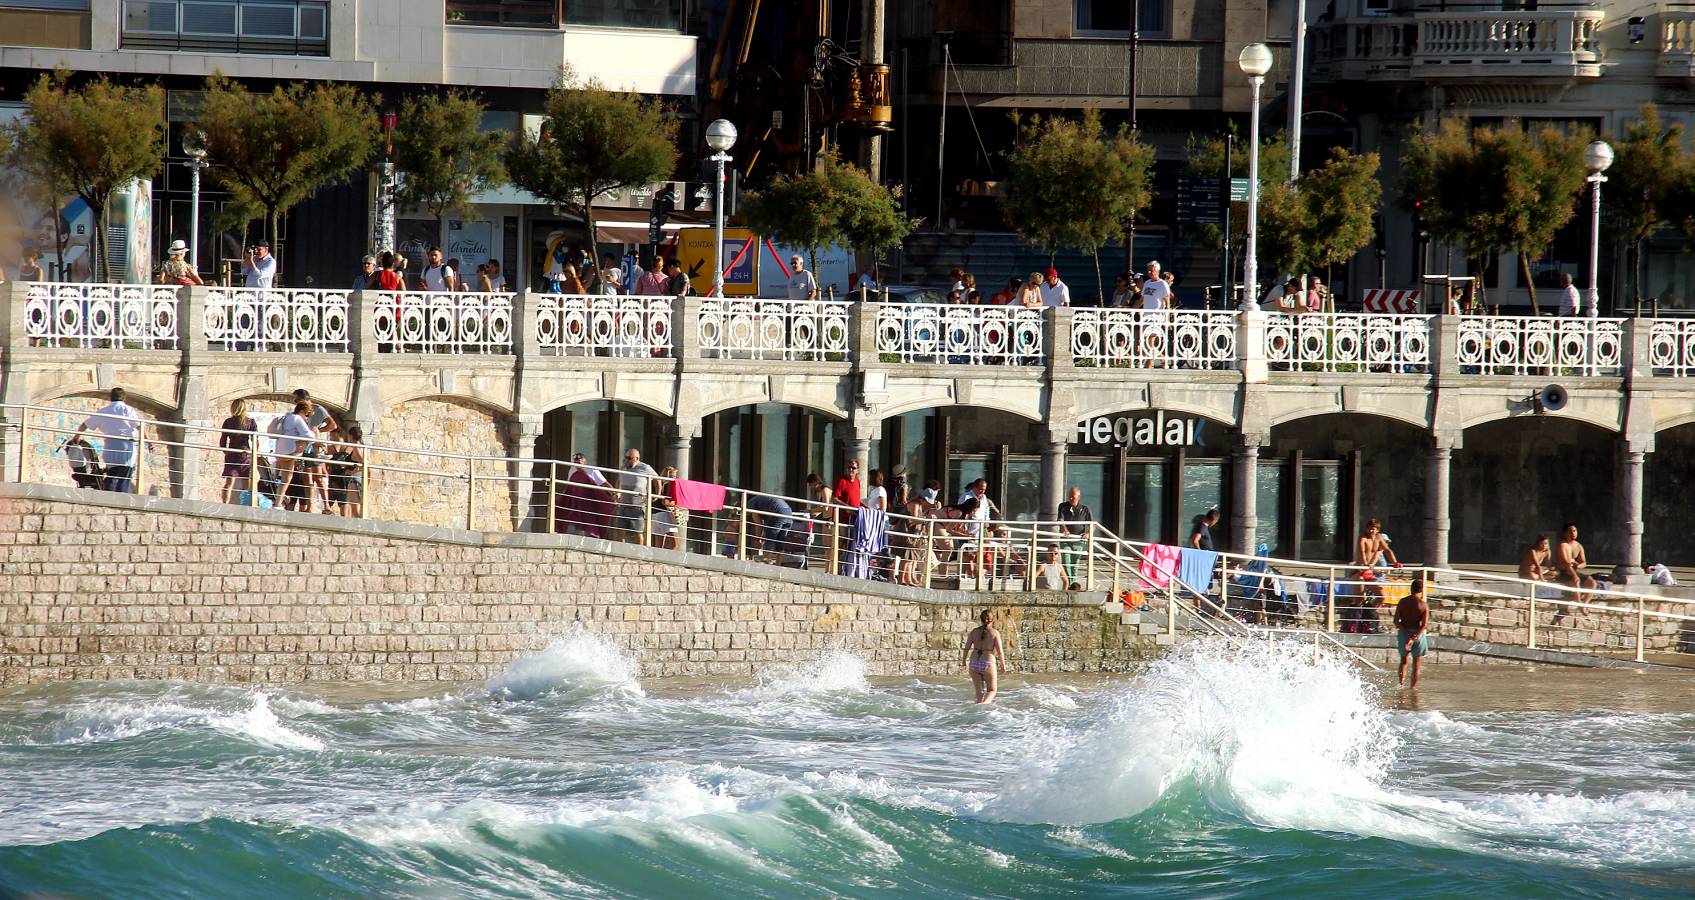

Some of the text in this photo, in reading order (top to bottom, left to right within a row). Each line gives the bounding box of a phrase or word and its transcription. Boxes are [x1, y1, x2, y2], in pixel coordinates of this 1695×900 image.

[398, 240, 431, 253] Arnold
[450, 240, 488, 254] Arnoldo
[688, 240, 714, 249] KONTXA
[723, 243, 748, 279] P
[733, 271, 743, 280] 24
[1067, 410, 1207, 451] Hegalak
